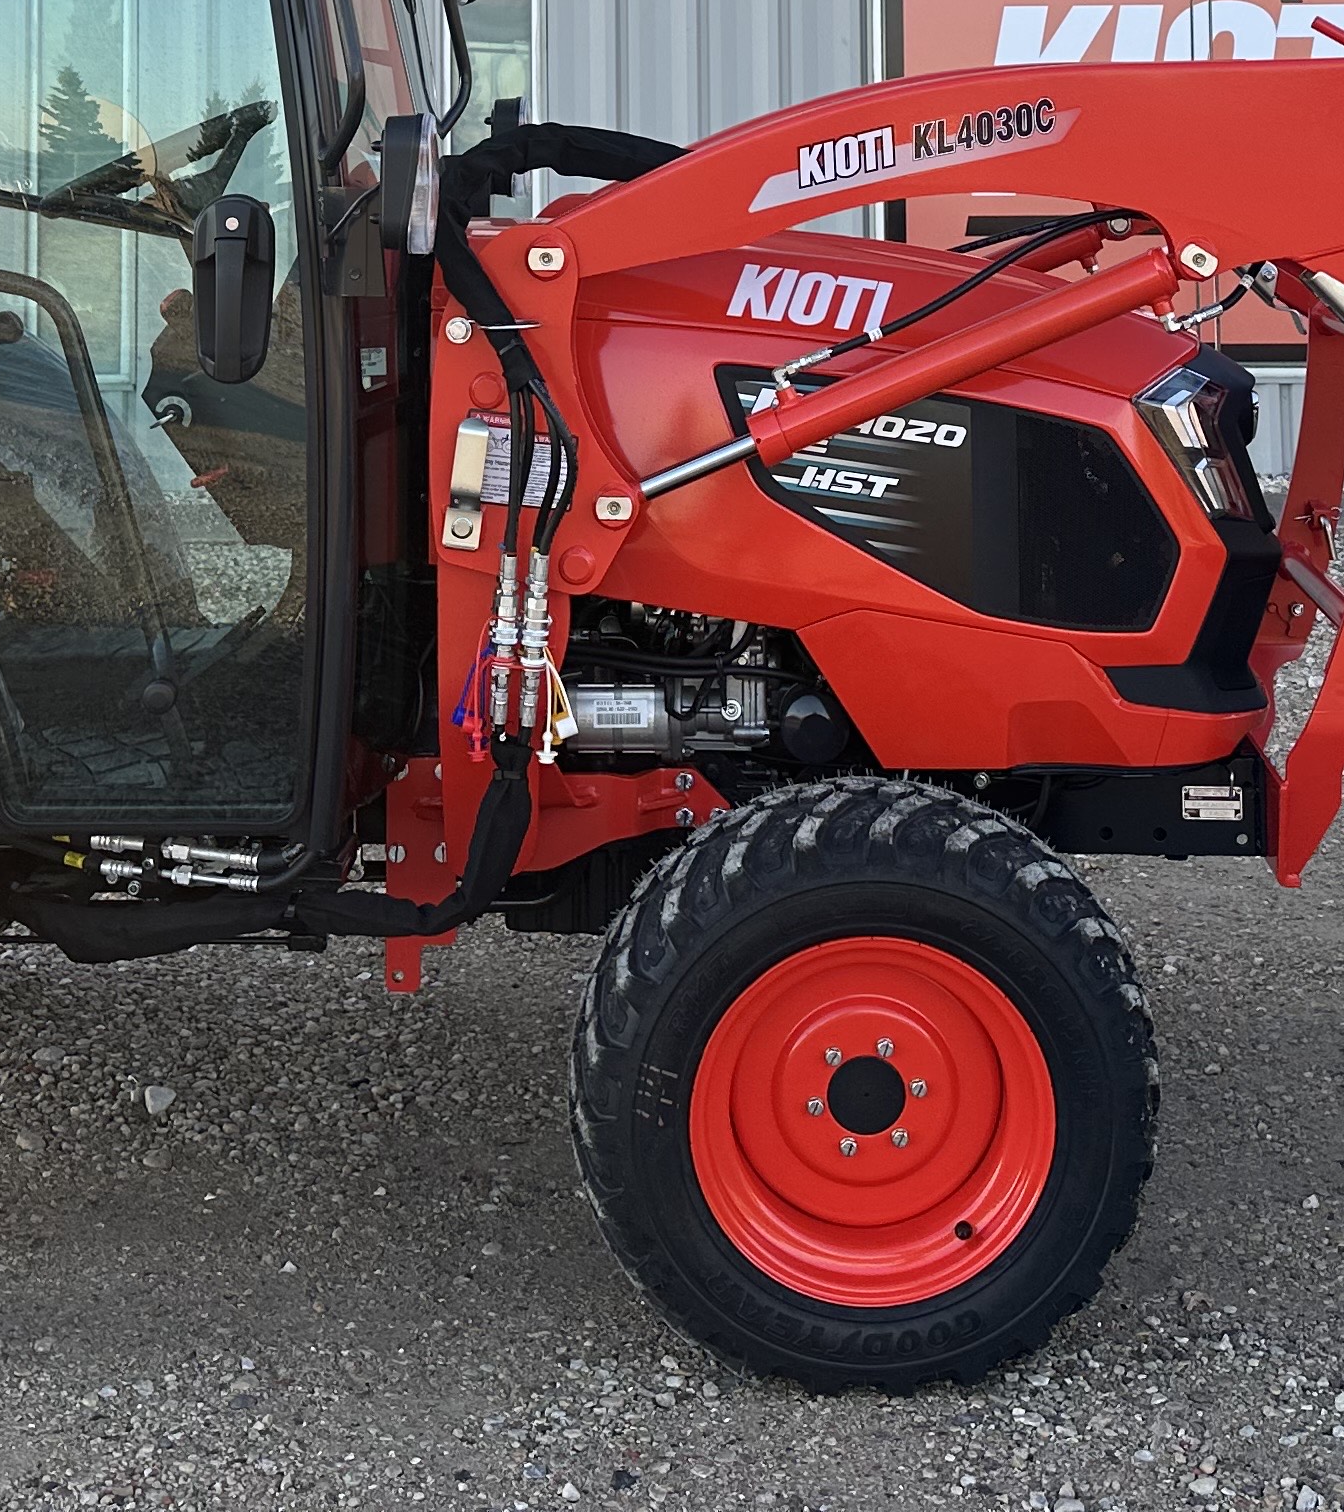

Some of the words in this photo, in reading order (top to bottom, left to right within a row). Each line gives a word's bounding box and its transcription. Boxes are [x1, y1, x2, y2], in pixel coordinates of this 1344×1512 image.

[798, 124, 897, 189] KIOTI
[912, 97, 1057, 162] KL4030C
[726, 263, 894, 334] KIOTI
[798, 465, 900, 498] HST
